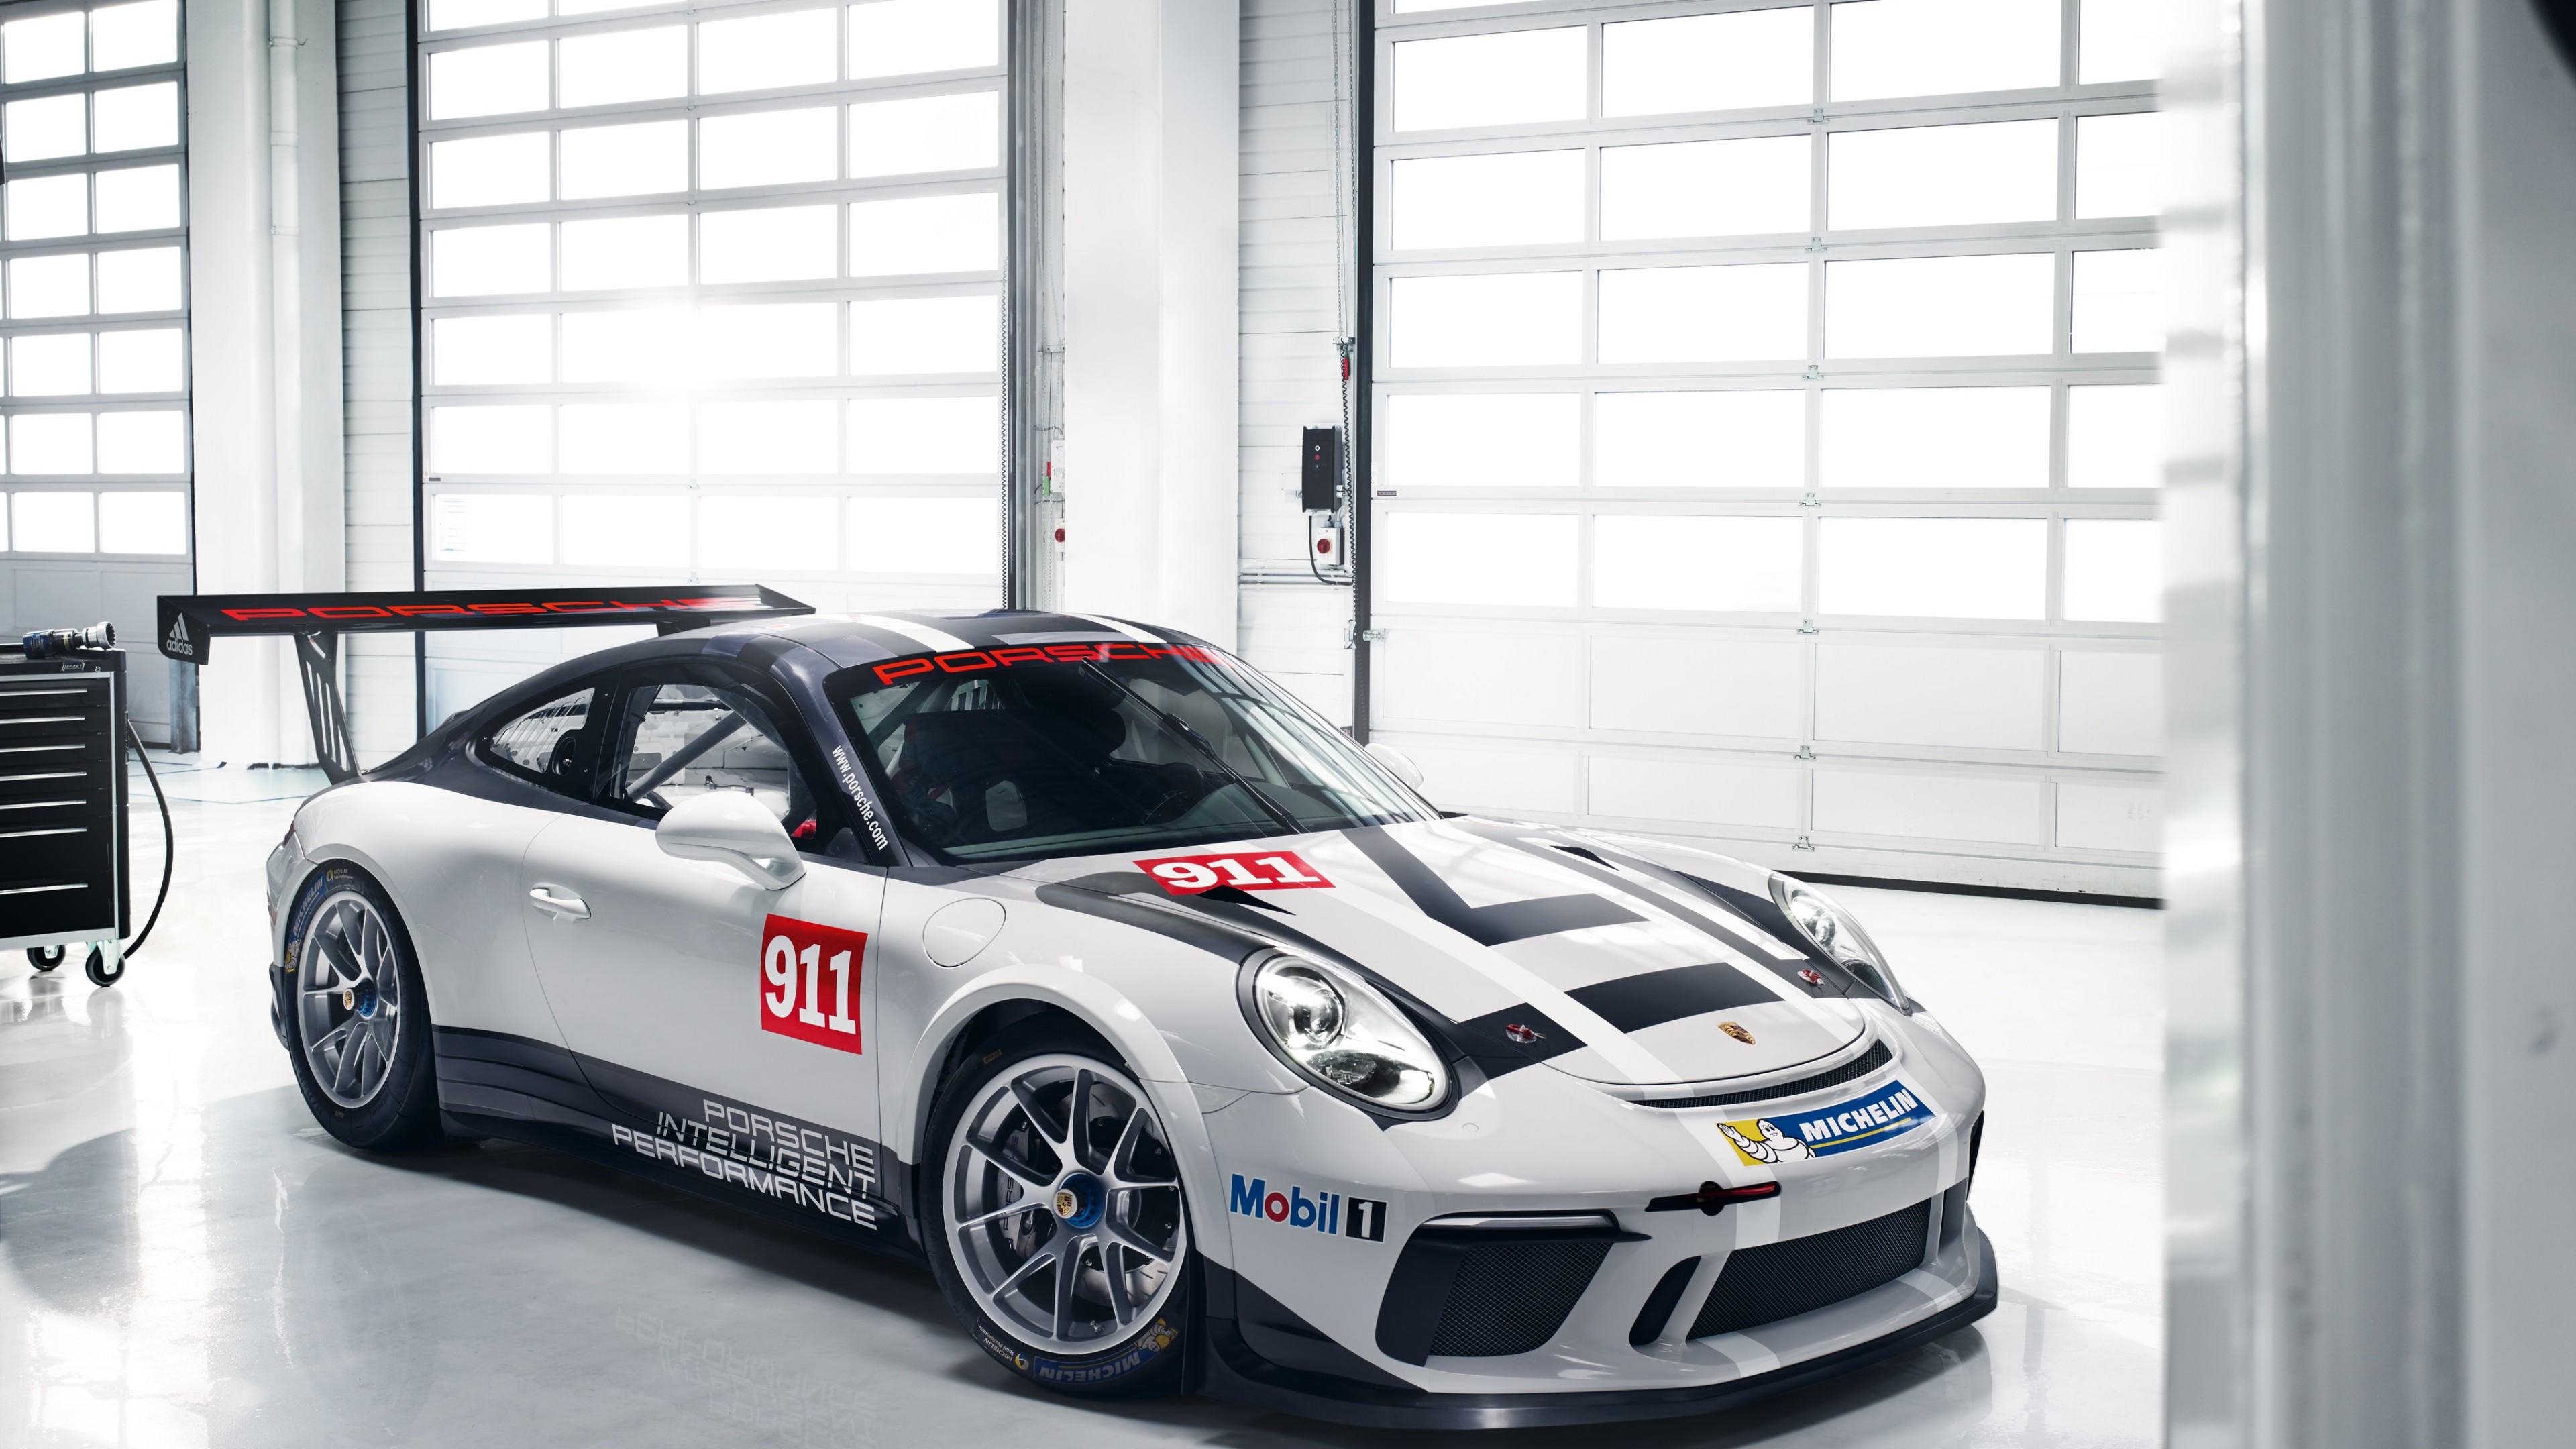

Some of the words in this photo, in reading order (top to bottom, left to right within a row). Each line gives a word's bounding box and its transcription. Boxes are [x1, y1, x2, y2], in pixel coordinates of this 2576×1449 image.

[220, 597, 758, 621] PORSCHE
[166, 638, 193, 656] adidas
[873, 643, 1229, 685] PORSCHE
[832, 745, 888, 851] www.porsche.com
[1152, 857, 1322, 888] 911
[292, 876, 323, 936] MICHELIN
[765, 934, 856, 1035] 911
[703, 1099, 875, 1174] PORSCHE
[1799, 1088, 1919, 1142] MICHELIN
[612, 1124, 877, 1230] PERFORMANCE
[656, 1111, 876, 1200] INTELLIGENT
[1230, 1173, 1340, 1236] Mobil
[1358, 1201, 1373, 1238] 1
[978, 1324, 1004, 1348] Performan
[983, 1338, 1013, 1362] MICHELIN
[1002, 1346, 1015, 1356] Total
[1040, 1350, 1141, 1382] MICHELIN
